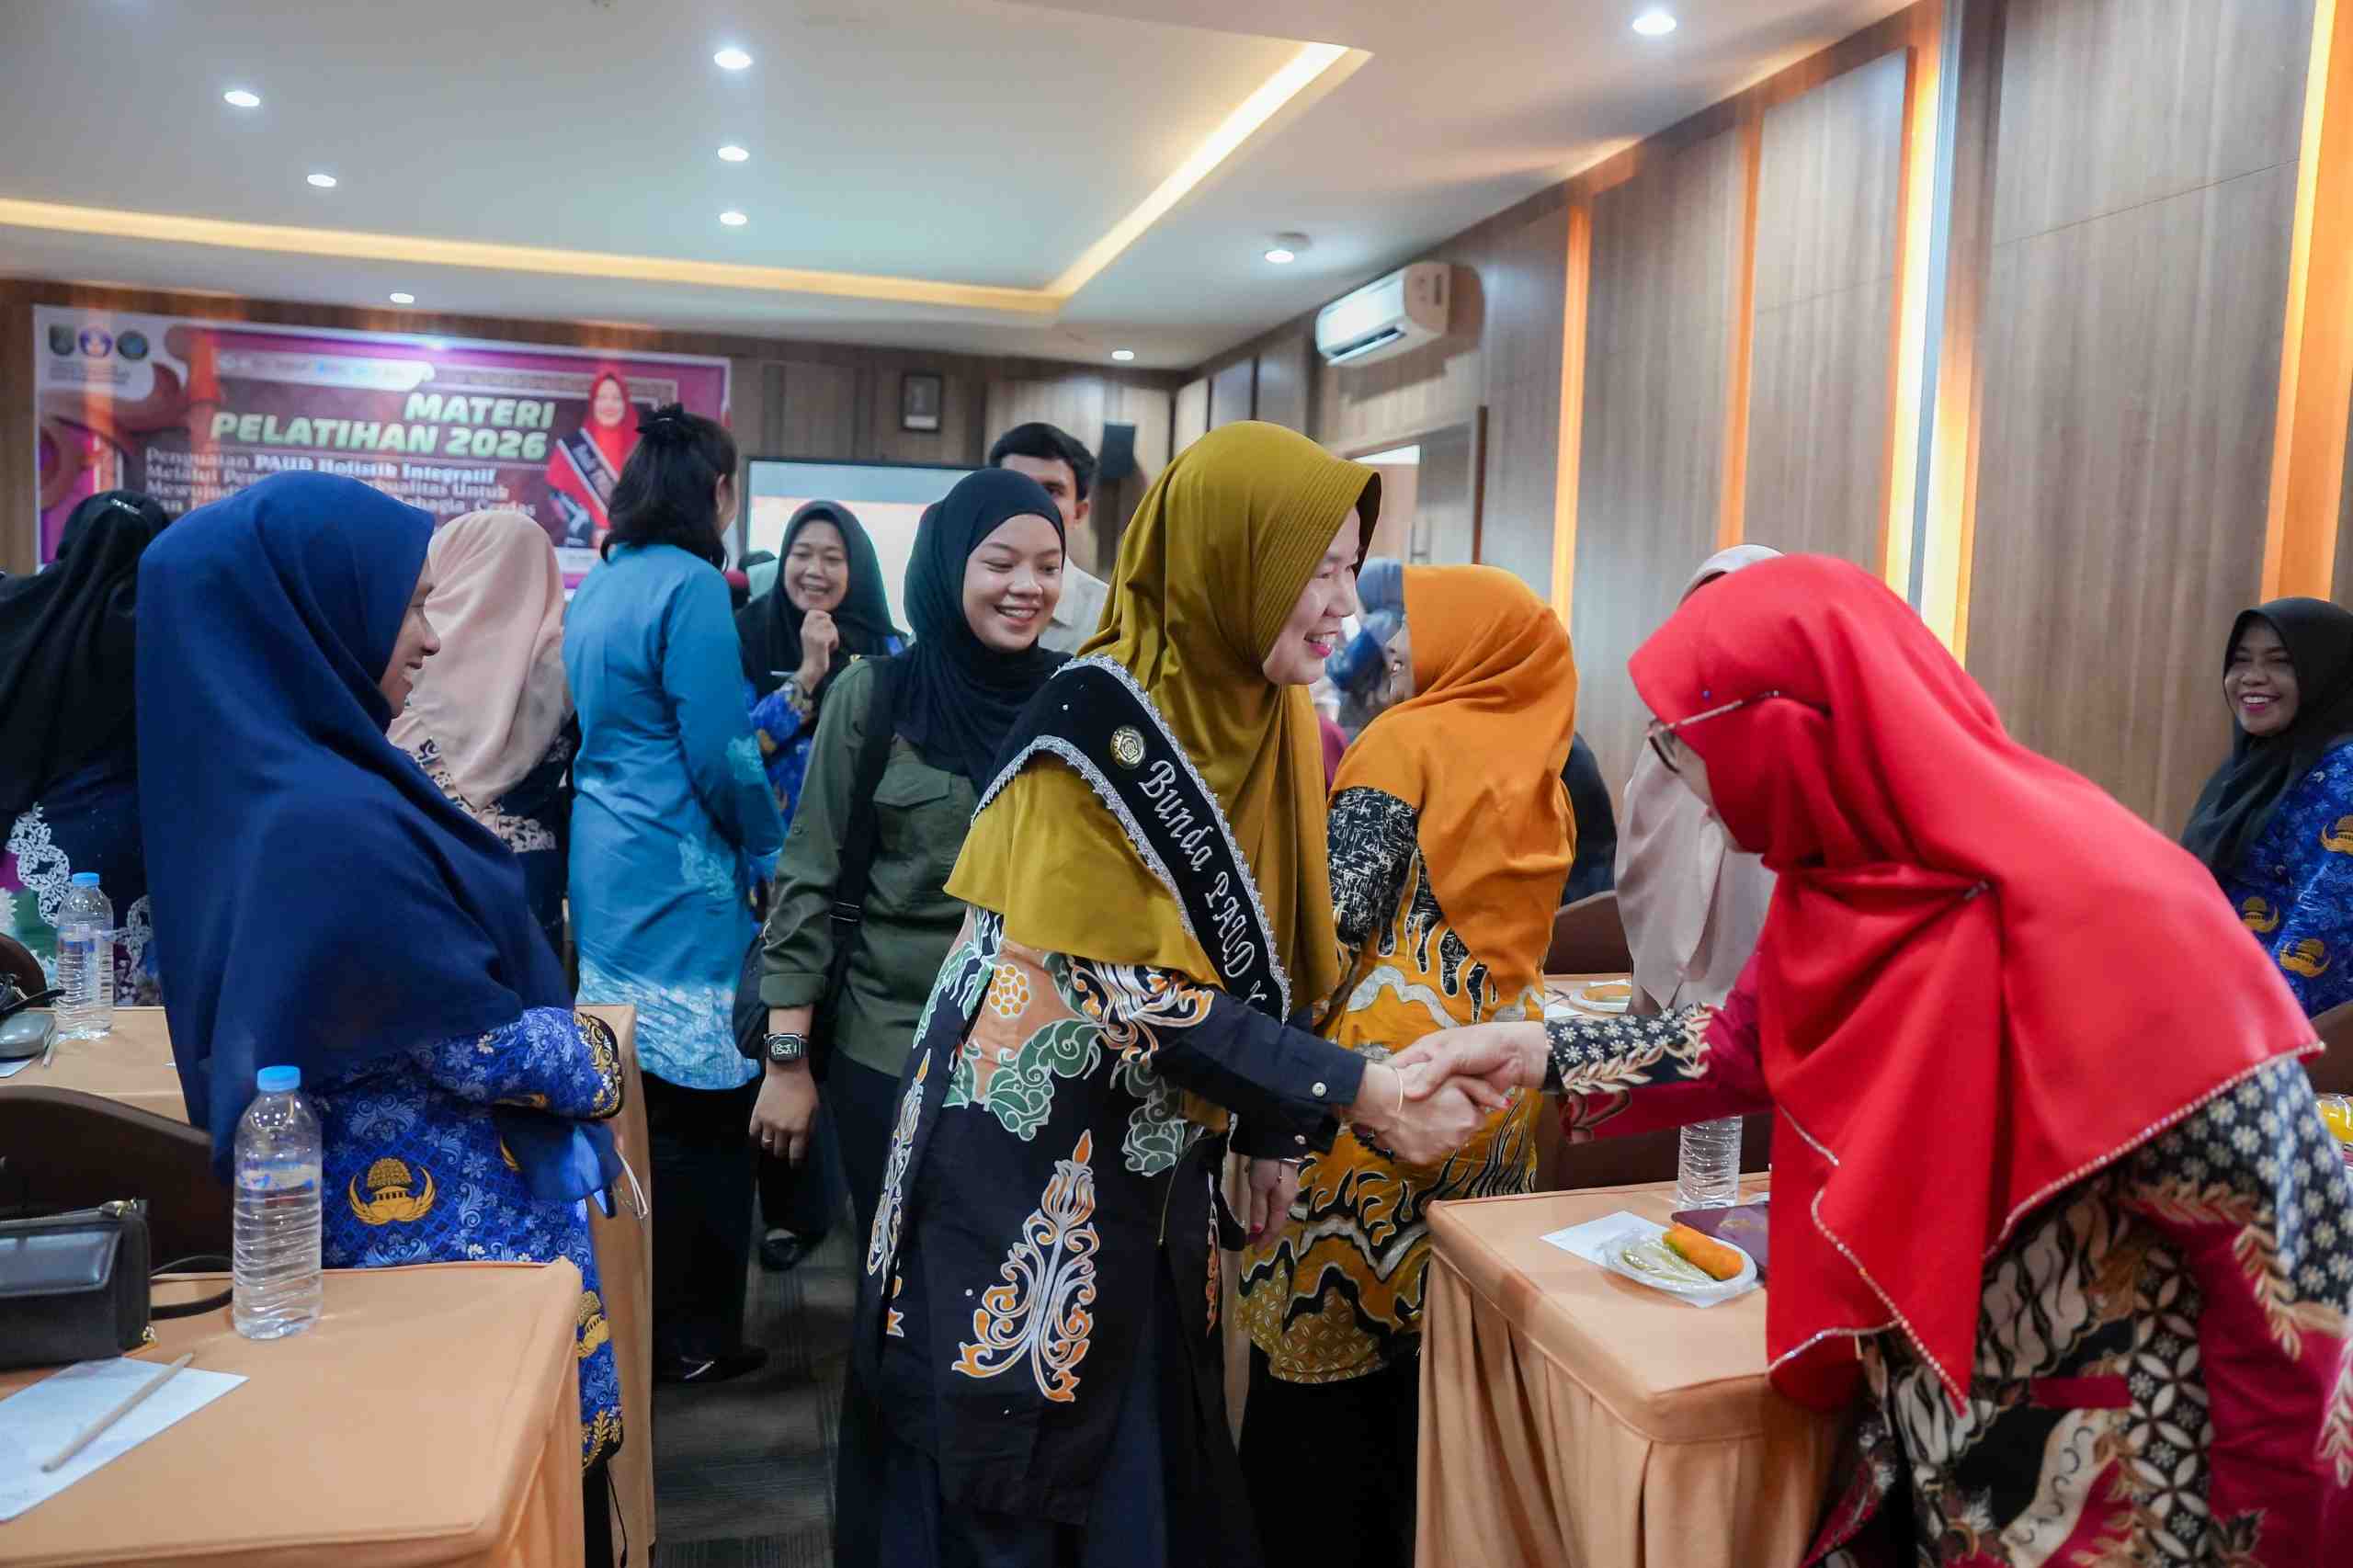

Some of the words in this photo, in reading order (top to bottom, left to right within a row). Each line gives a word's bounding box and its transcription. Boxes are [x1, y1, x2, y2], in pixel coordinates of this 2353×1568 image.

[404, 392, 556, 429] MATERI
[210, 412, 439, 454] PELATIHAN
[445, 426, 548, 460] 2026
[255, 454, 313, 472] PAUD
[402, 461, 497, 486] Integratif
[451, 483, 510, 502] Untuk
[1138, 759, 1214, 872] Bunda
[1203, 870, 1256, 979] PAUD
